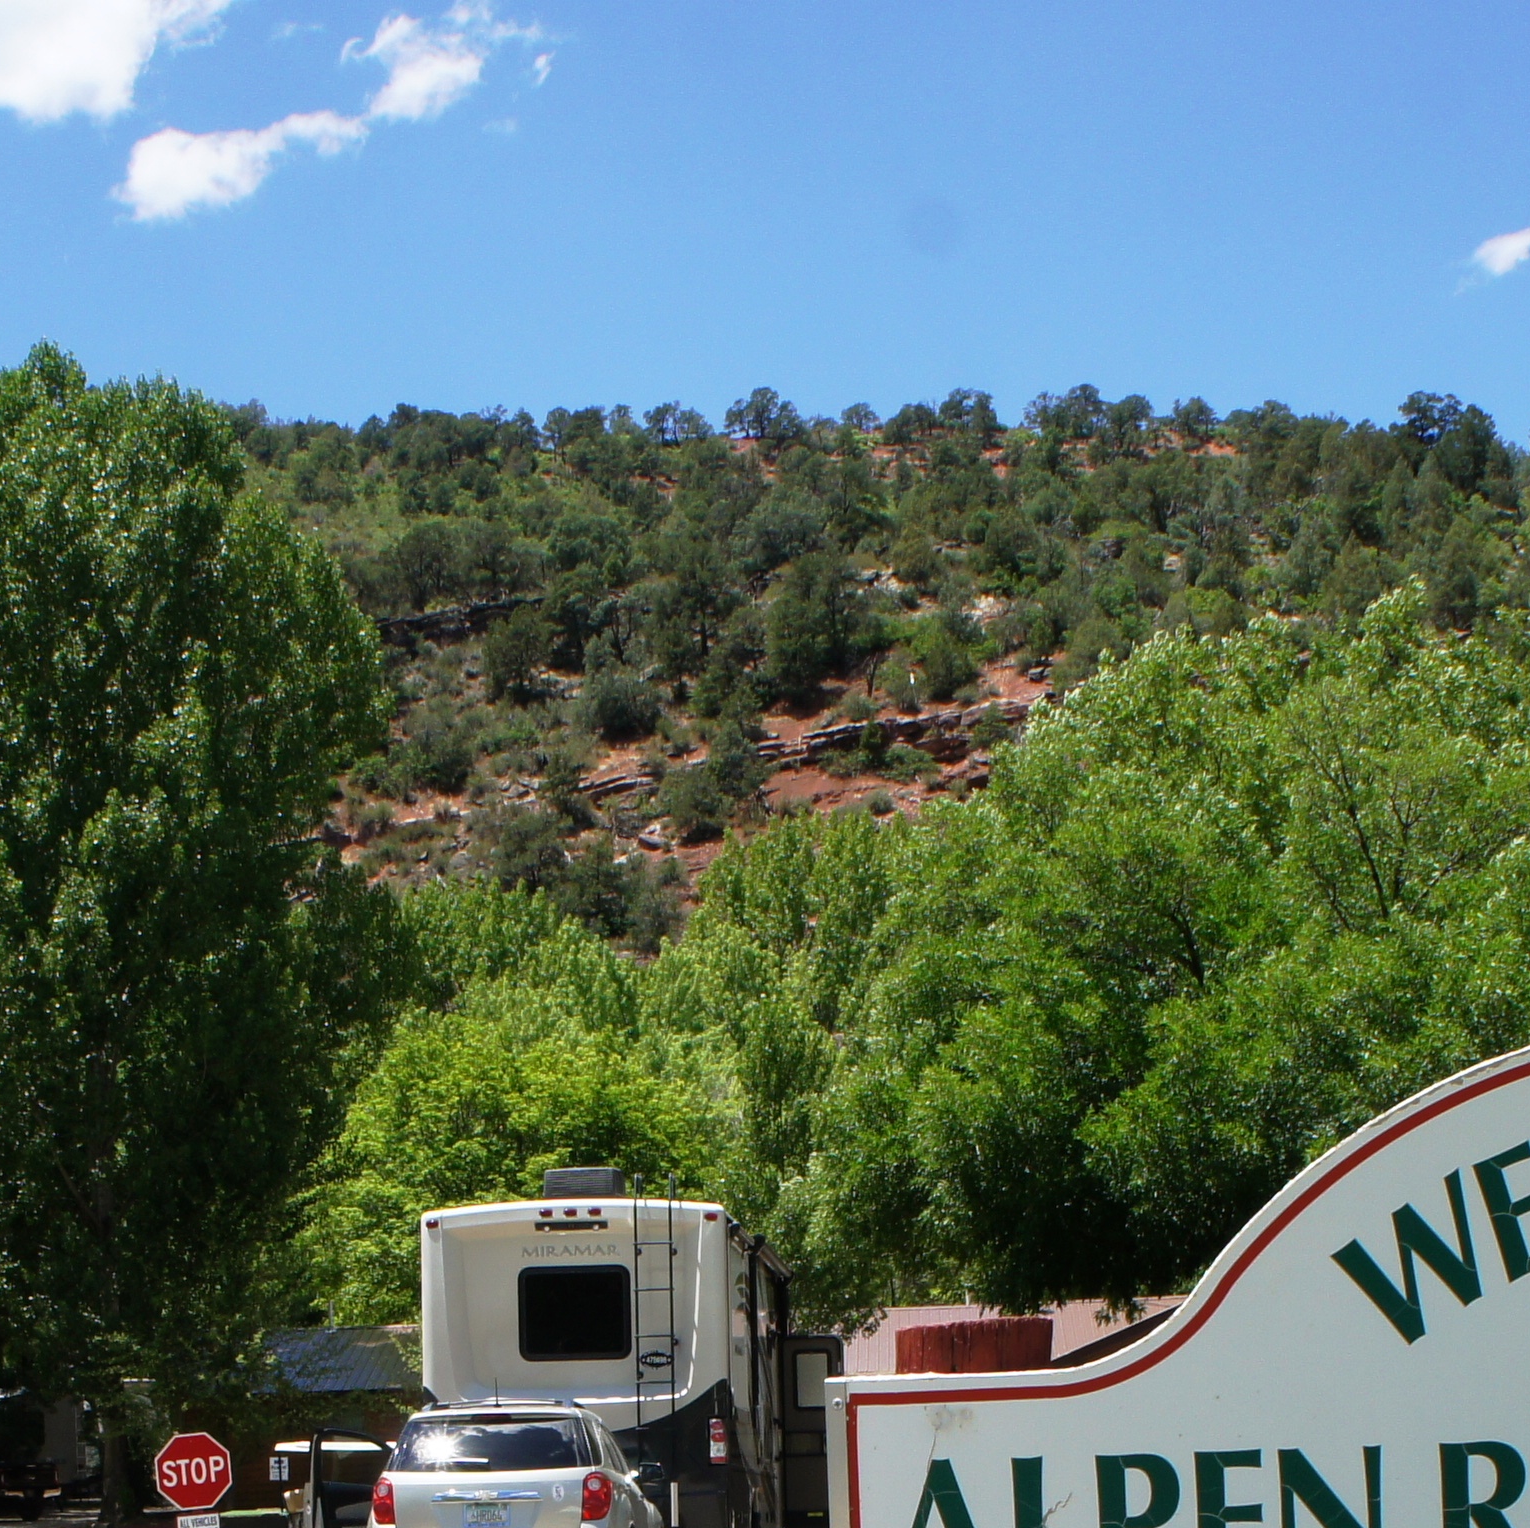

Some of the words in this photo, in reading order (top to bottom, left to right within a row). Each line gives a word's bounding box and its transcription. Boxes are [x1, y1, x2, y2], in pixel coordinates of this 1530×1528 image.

[521, 1244, 620, 1258] MIRAMAR
[162, 1455, 225, 1488] STOP
[180, 1518, 190, 1528] ALL
[191, 1516, 217, 1527] VEHICLES
